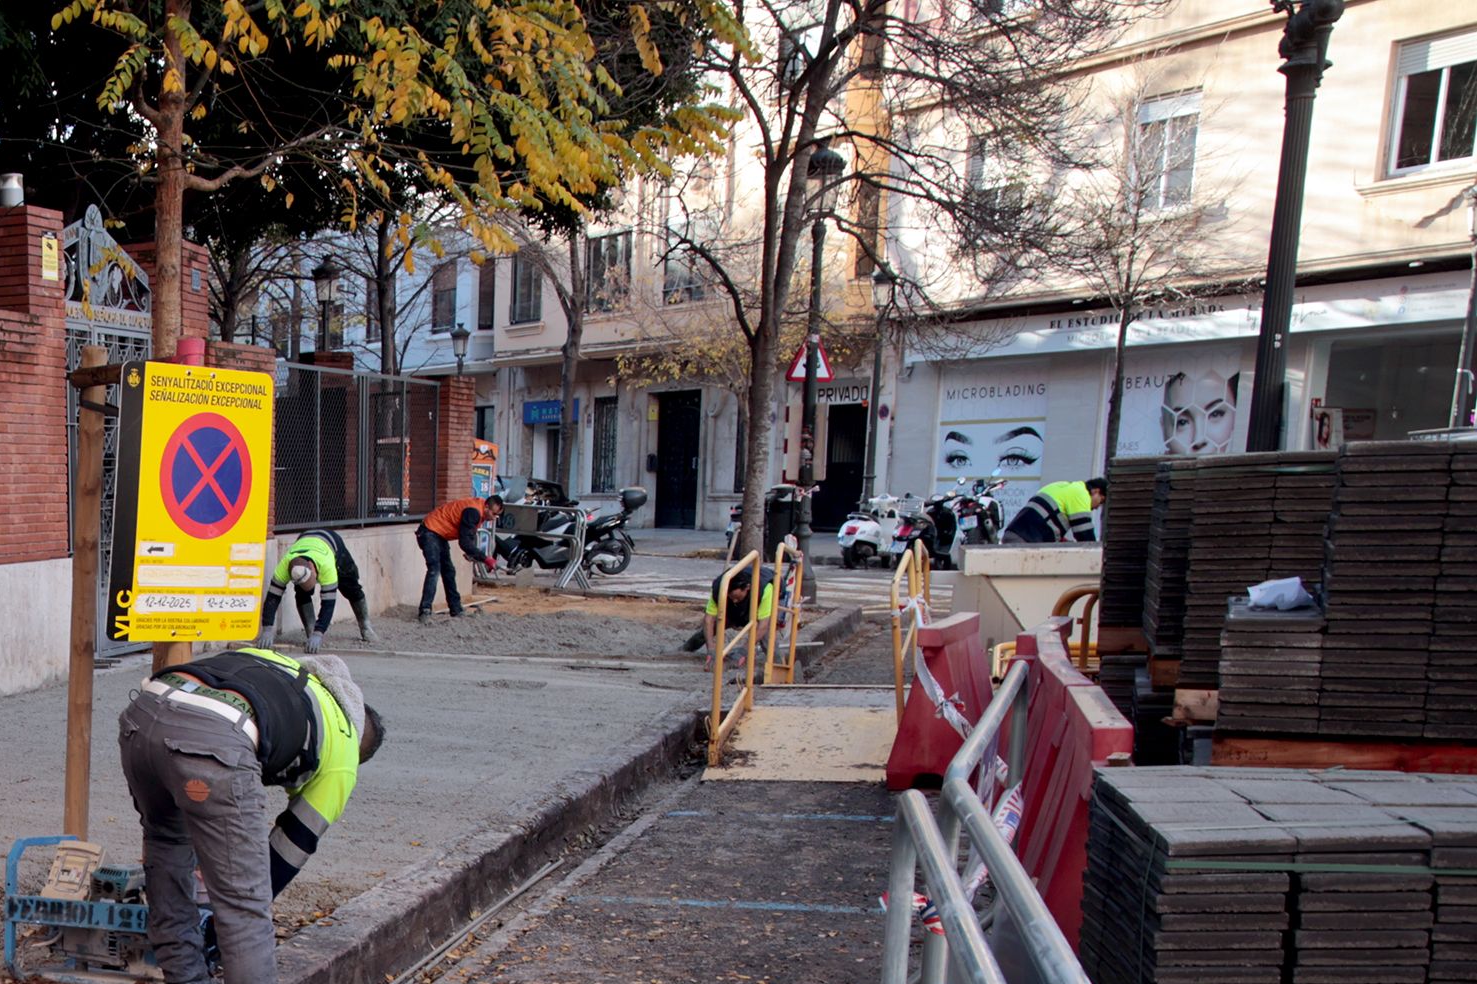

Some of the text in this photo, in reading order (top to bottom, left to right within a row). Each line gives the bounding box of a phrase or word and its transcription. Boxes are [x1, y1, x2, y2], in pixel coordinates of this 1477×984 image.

[1050, 319, 1063, 329] EL
[1148, 309, 1164, 319] LA
[151, 375, 268, 397] SENYALITZACIÓ EXCEPCIONAL
[1126, 373, 1187, 390] BEAUTY
[149, 388, 263, 410] SEÑALIZACIÓN EXCEPCIONAL
[817, 385, 869, 402] PRIVADO
[946, 383, 1047, 400] MICROBLADING
[144, 595, 191, 609] 12-12-2025
[113, 589, 133, 639] VLC
